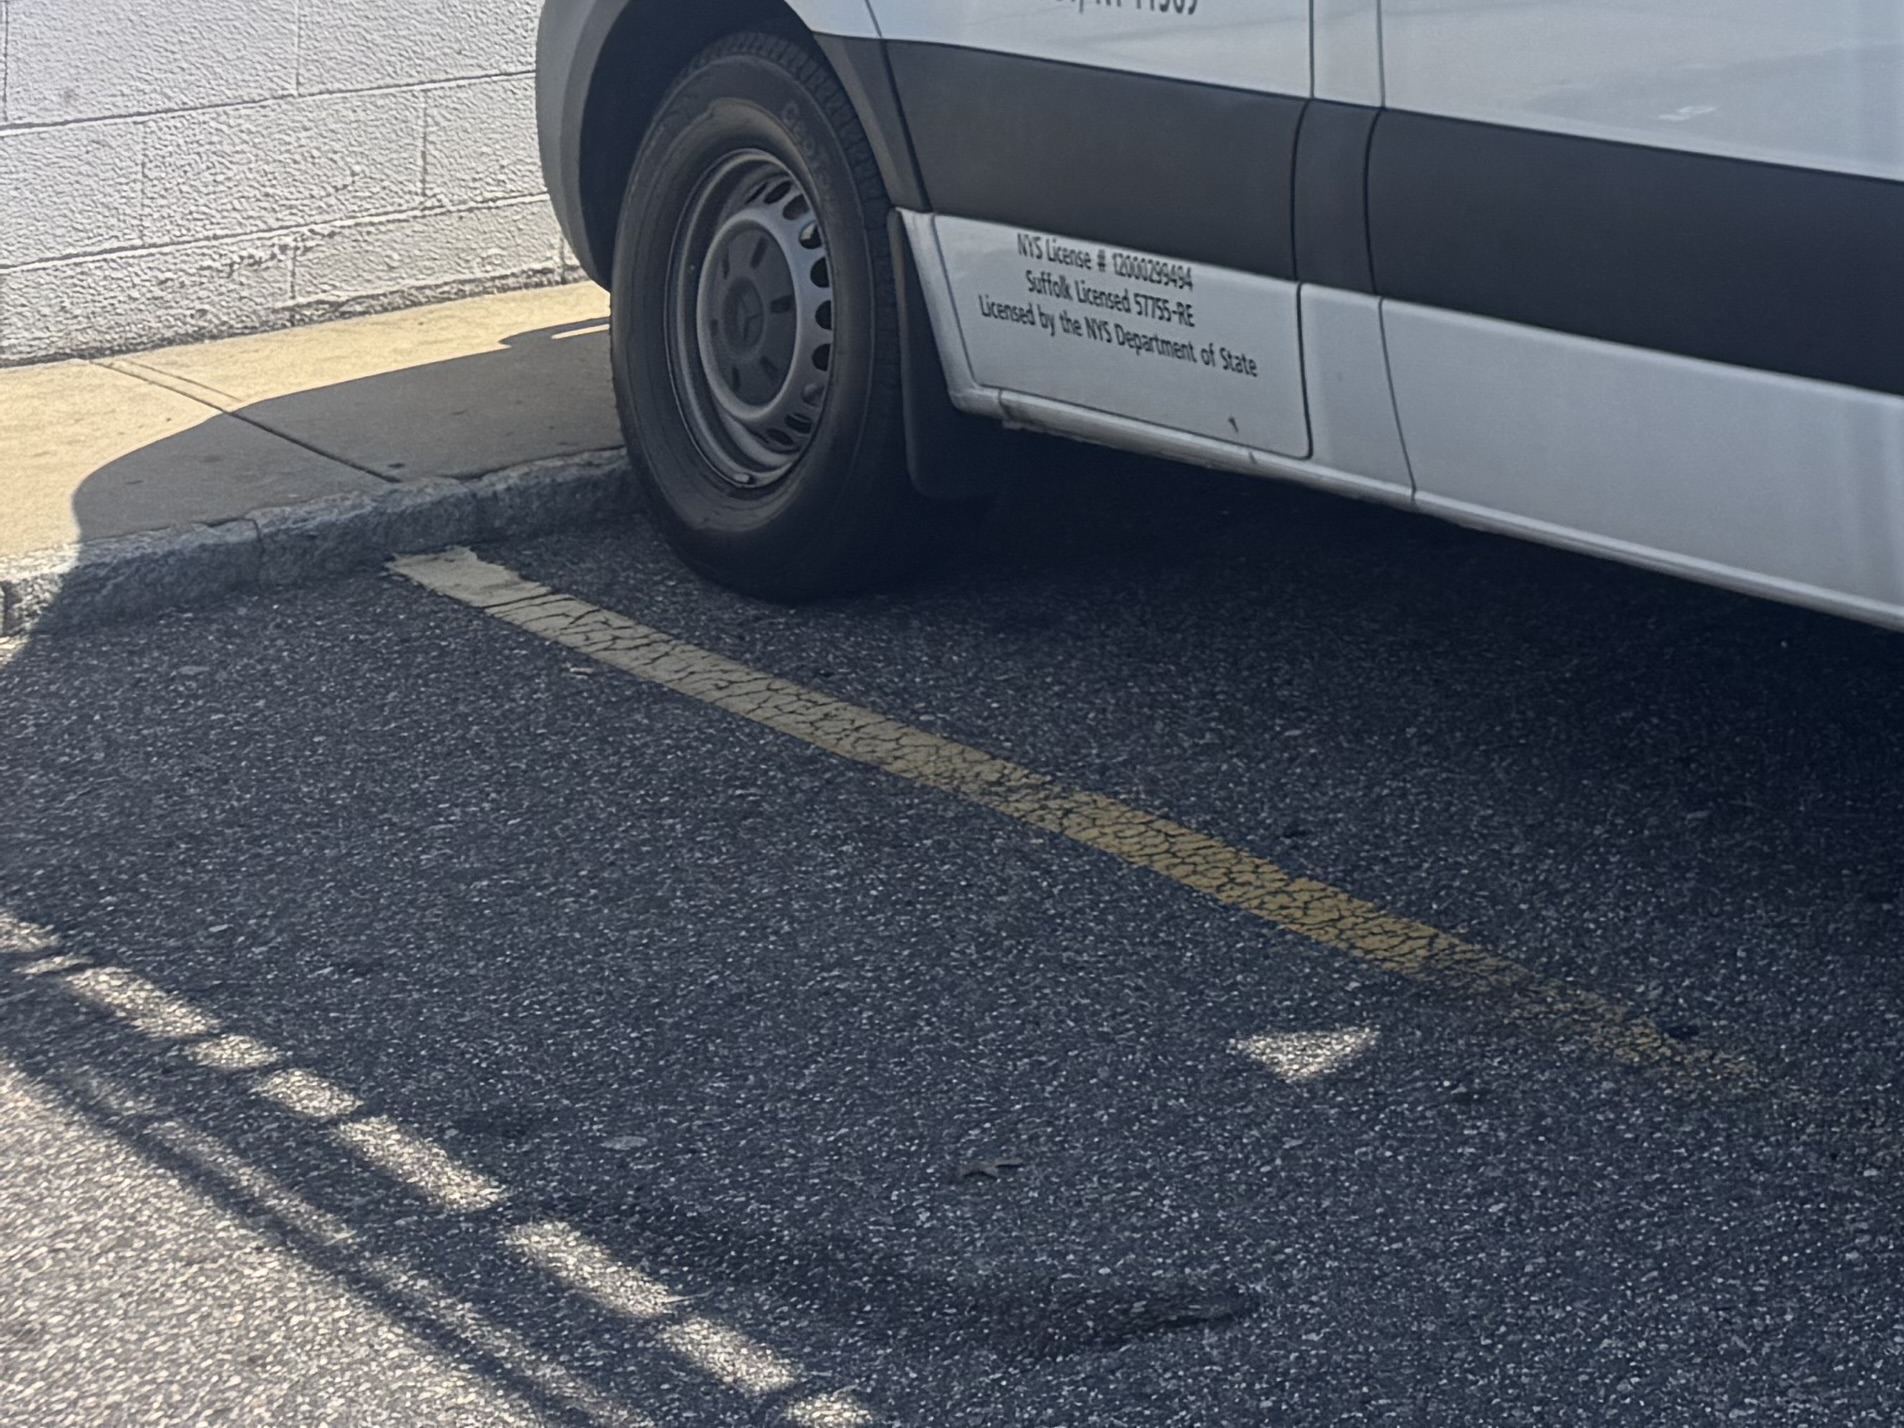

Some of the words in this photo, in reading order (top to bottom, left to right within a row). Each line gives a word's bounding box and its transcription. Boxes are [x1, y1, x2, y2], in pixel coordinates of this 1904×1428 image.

[1017, 232, 1044, 260] NYS
[1045, 237, 1092, 270] License
[1025, 269, 1072, 302] Suffolk
[1075, 277, 1132, 315] Licensed
[978, 294, 1036, 326] Licensed
[1039, 305, 1056, 337] by
[1059, 308, 1083, 336] the
[1085, 315, 1113, 345] NYS
[1113, 323, 1198, 363] Department
[1200, 343, 1217, 368] of
[1219, 346, 1259, 378] State
